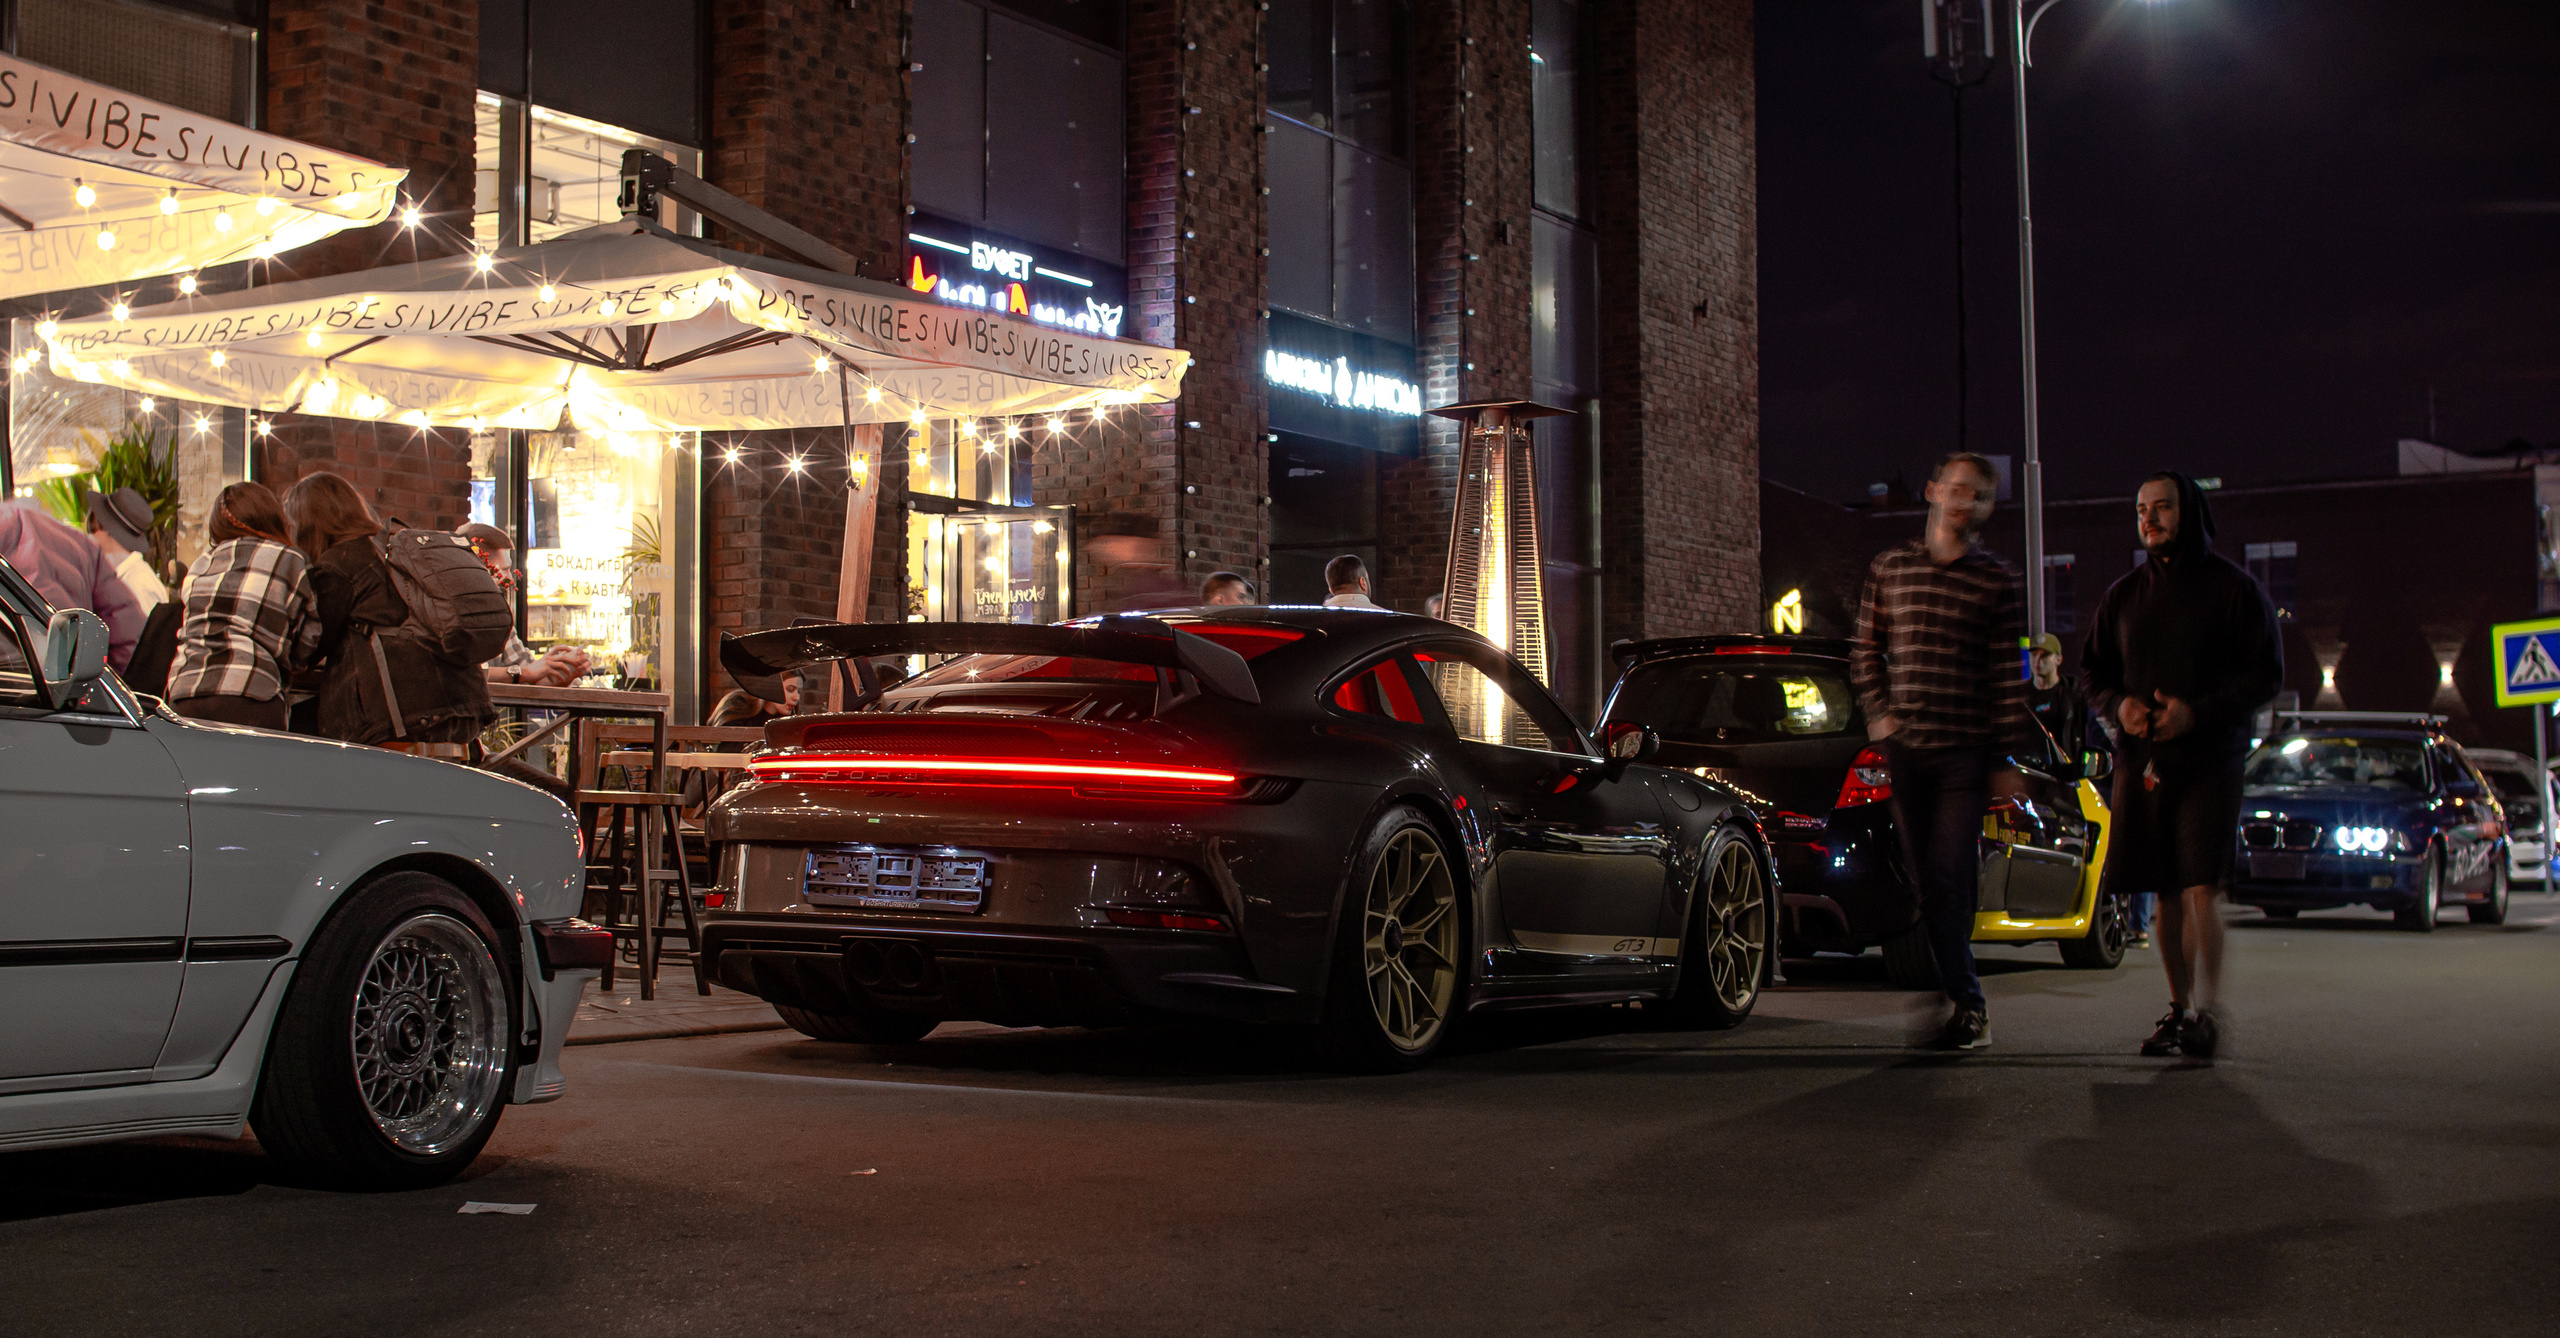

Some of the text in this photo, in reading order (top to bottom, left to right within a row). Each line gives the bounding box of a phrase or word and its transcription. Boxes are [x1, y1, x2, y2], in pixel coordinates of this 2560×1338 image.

[972, 241, 1033, 281] БУФЕТ
[547, 554, 593, 571] БОКАЛ
[572, 580, 580, 594] К
[1613, 939, 1645, 952] GT3
